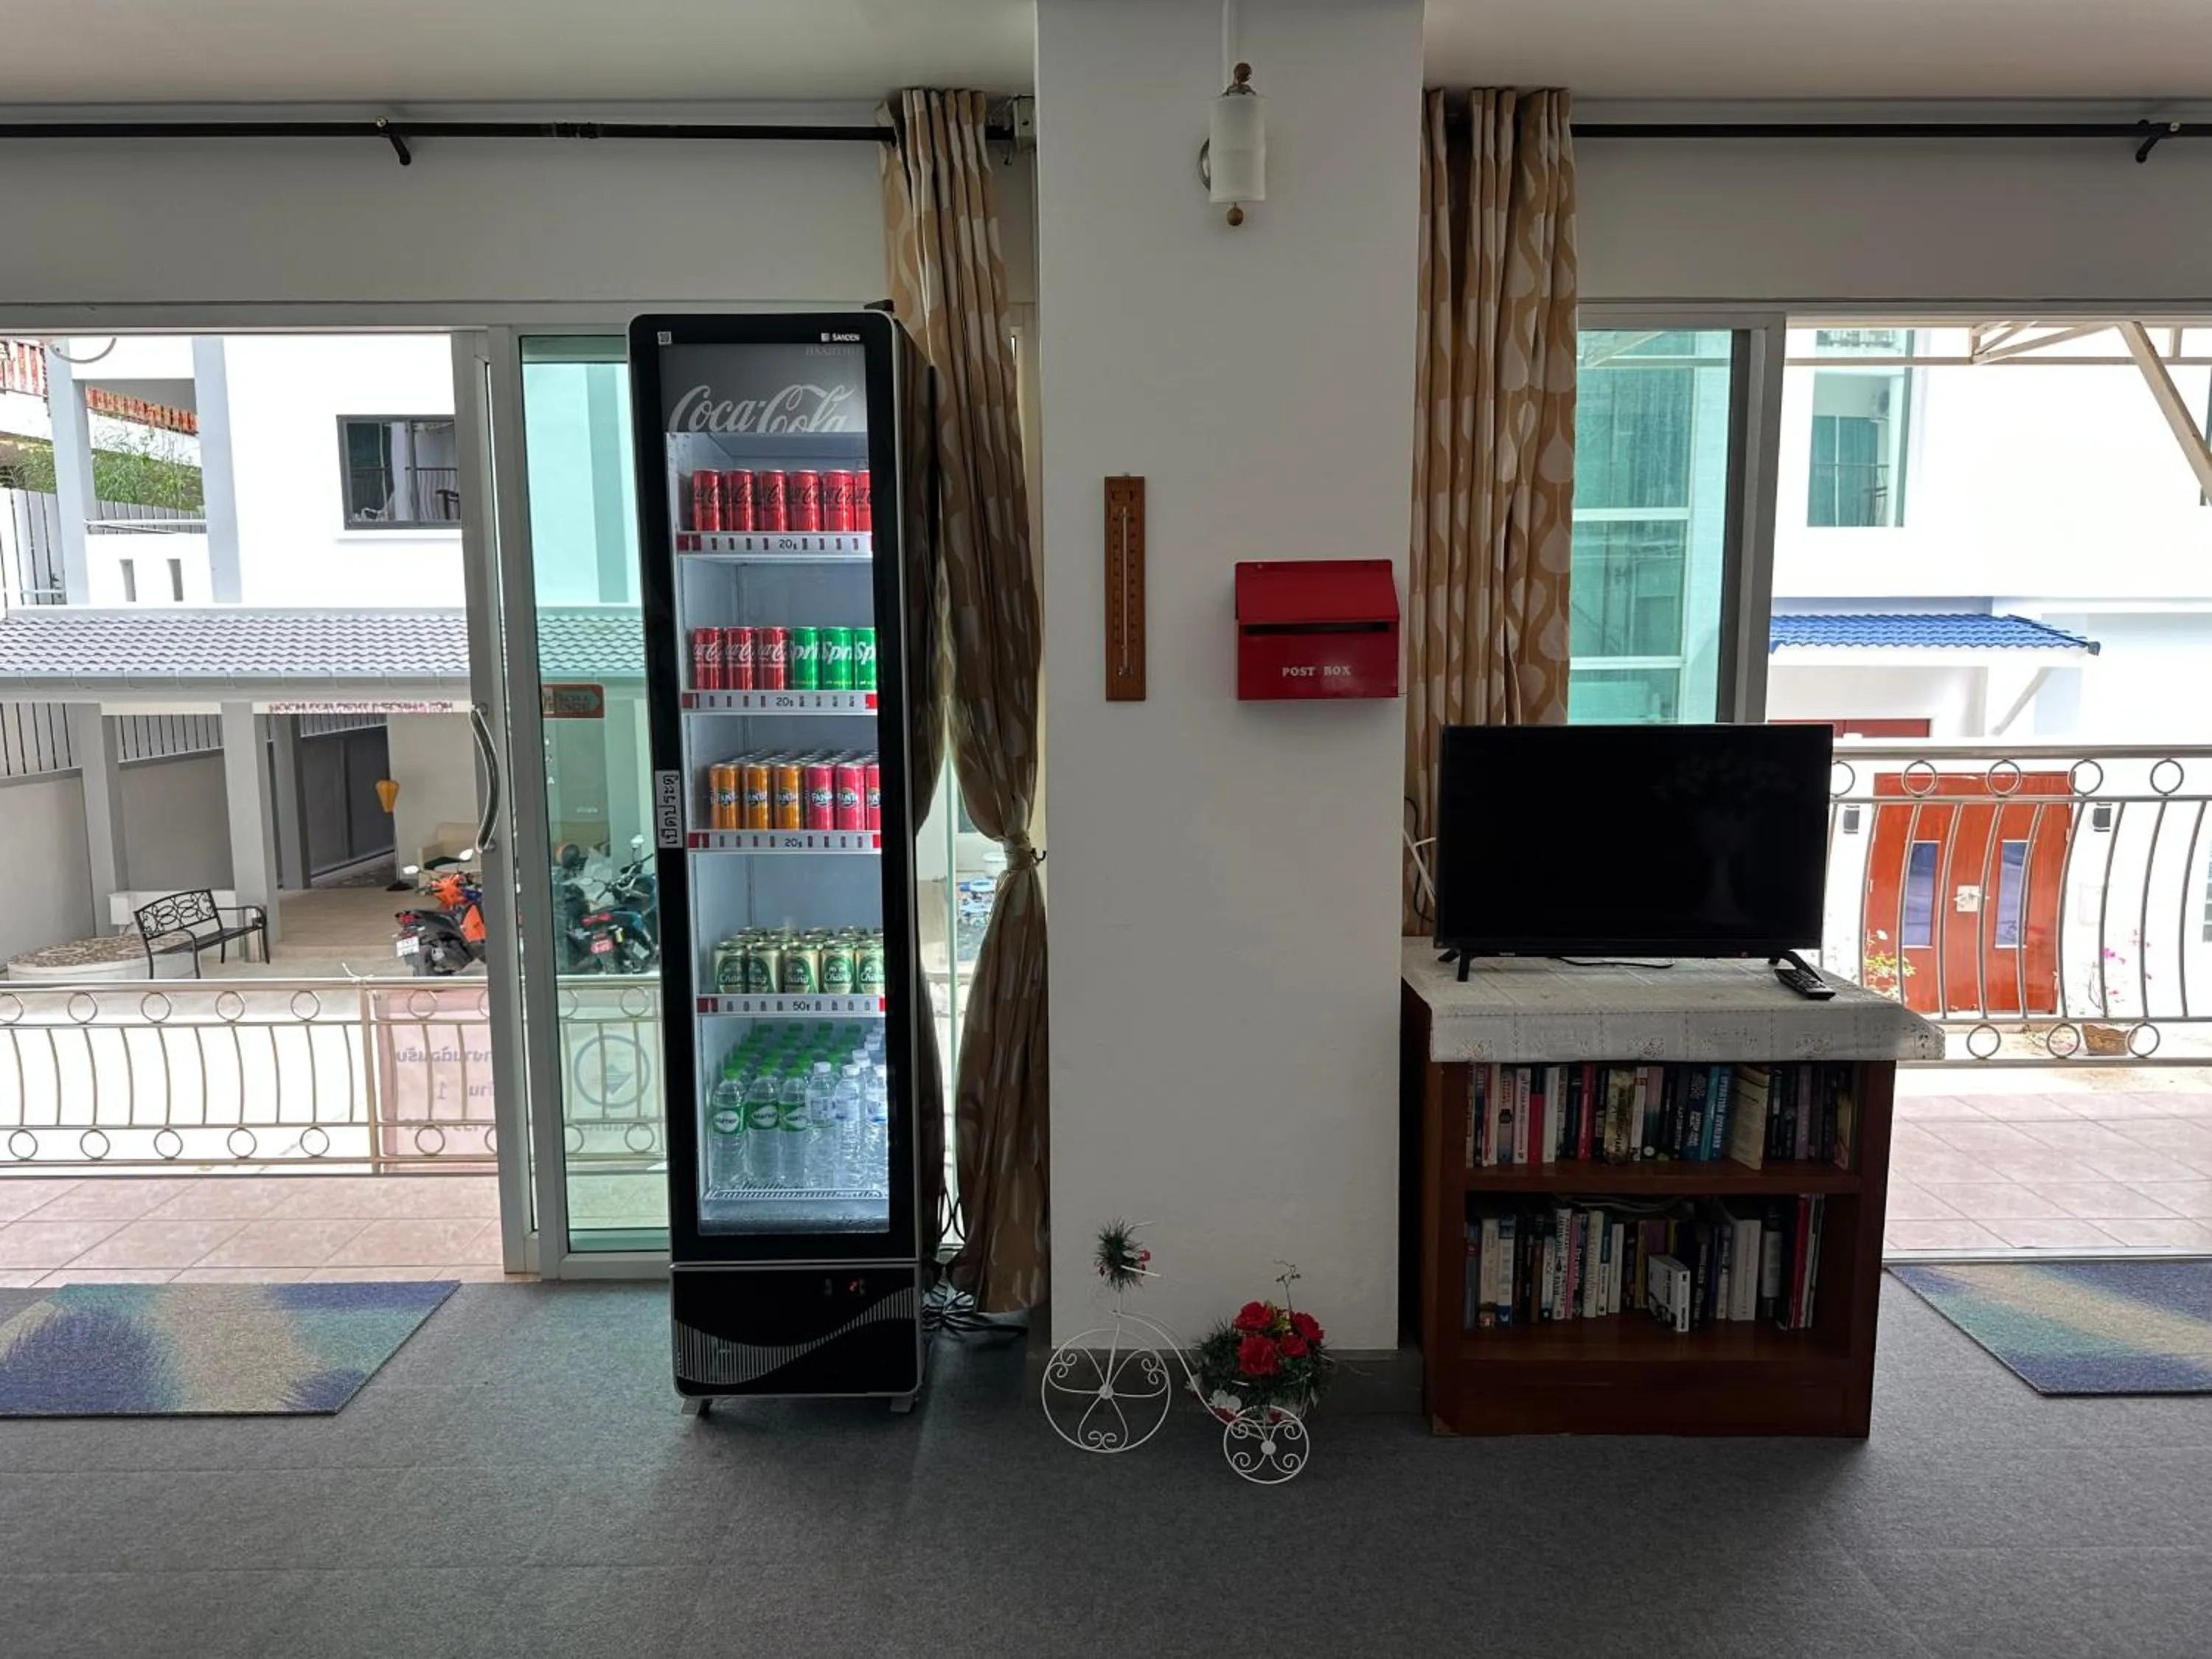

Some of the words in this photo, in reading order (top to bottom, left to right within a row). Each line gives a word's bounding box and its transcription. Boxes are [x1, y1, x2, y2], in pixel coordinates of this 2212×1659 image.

[1281, 666, 1316, 678] POST
[1324, 665, 1352, 676] BOX
[658, 775, 678, 845] เปิดประตู
